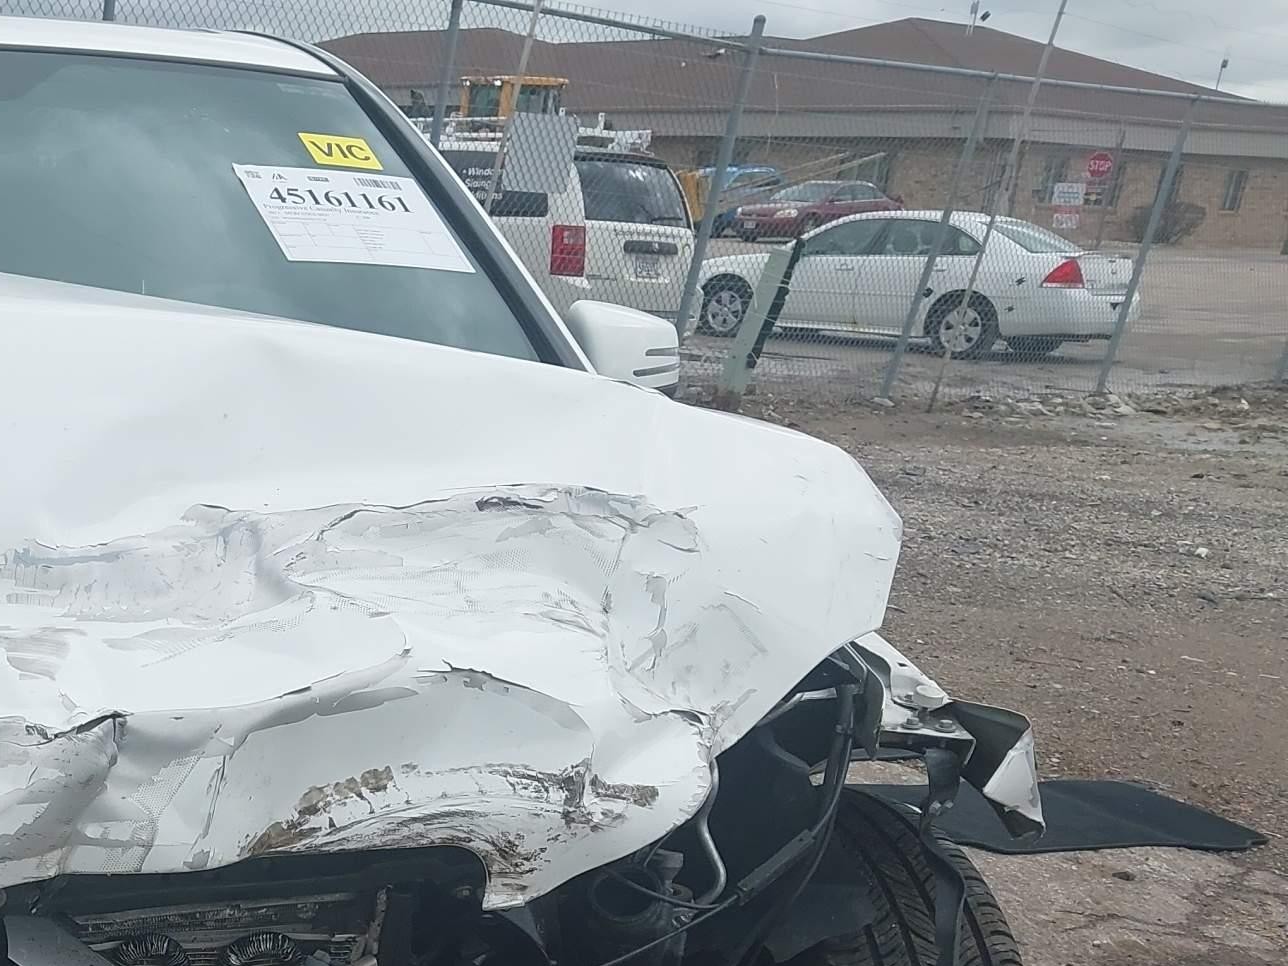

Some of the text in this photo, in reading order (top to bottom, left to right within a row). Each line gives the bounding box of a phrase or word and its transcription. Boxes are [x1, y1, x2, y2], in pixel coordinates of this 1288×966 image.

[309, 140, 370, 161] VIC
[1089, 159, 1112, 171] STOP
[269, 186, 415, 213] 45161161
